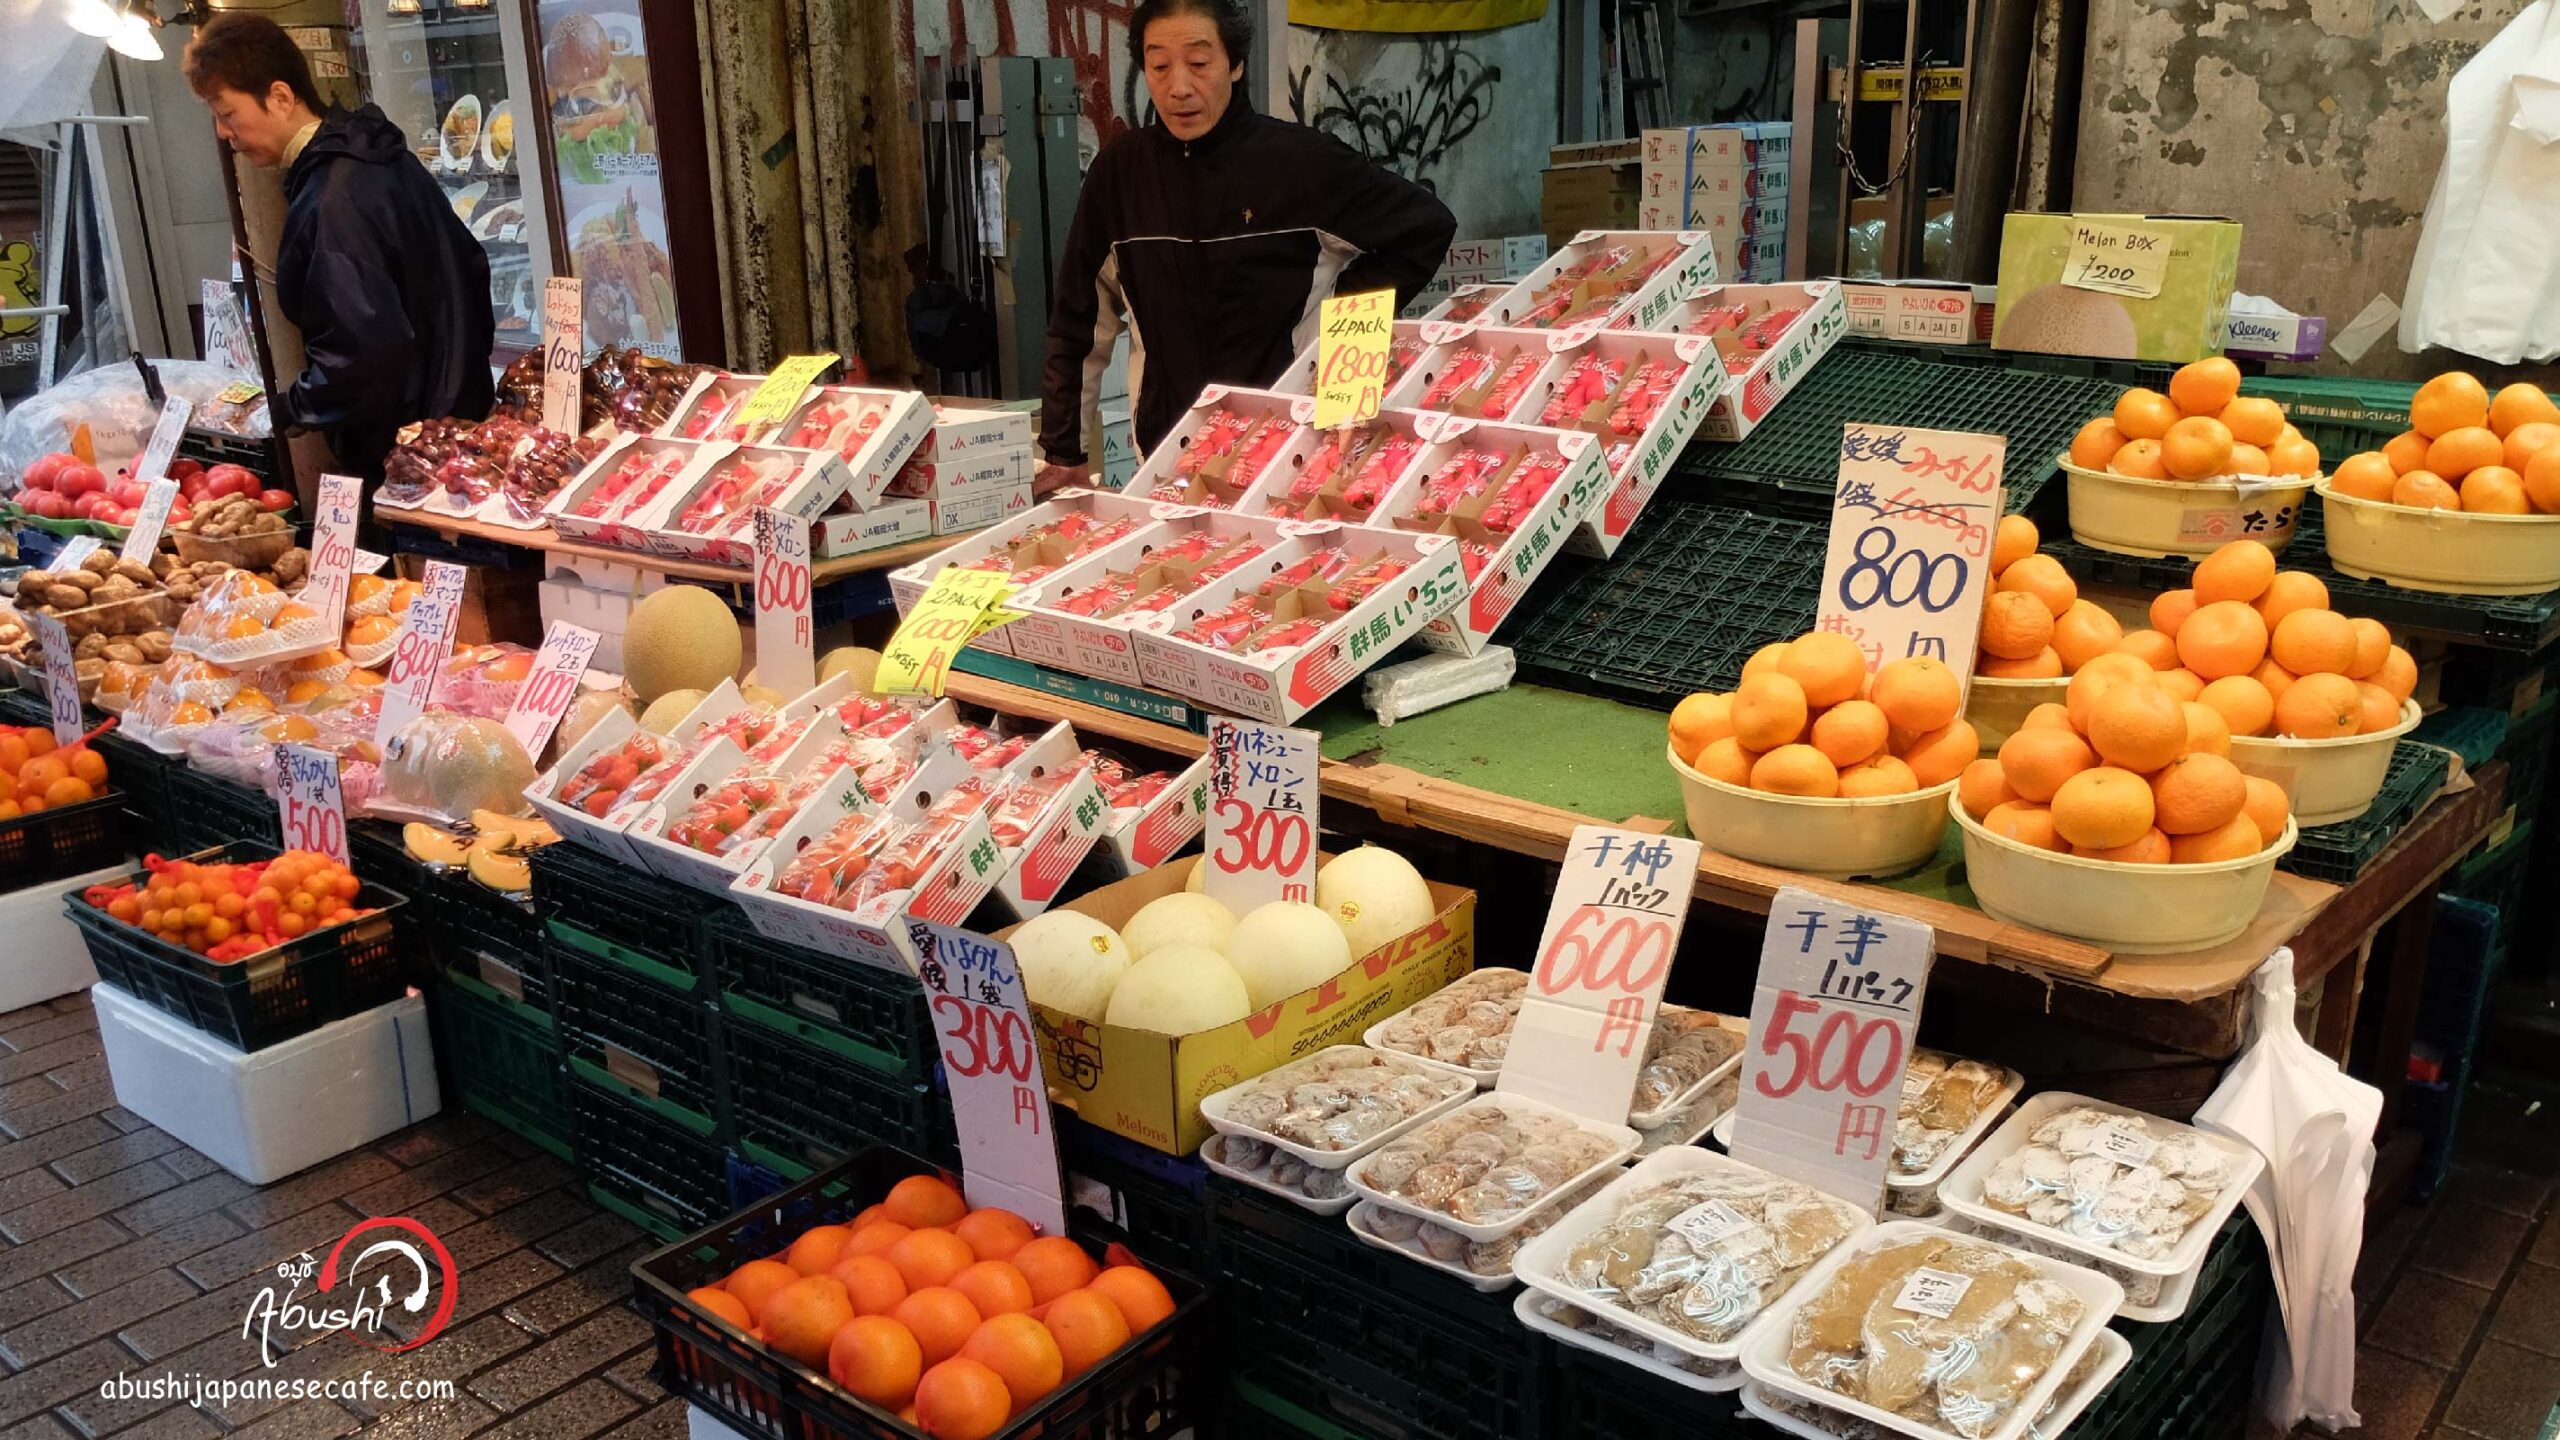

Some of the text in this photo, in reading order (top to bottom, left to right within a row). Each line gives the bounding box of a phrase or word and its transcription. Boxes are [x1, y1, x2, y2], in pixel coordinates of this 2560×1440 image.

[2078, 228, 2116, 248] Melon
[1450, 246, 1489, 266] トマト
[2080, 255, 2135, 282] ¥200
[1641, 250, 1712, 329] 群馬いちご
[1332, 295, 1384, 315] イチゴ
[1327, 317, 1387, 337] 4PACK
[1778, 300, 1842, 380] 群馬いちご
[1873, 318, 1880, 328] M
[1919, 322, 1926, 331] A
[1933, 323, 1943, 332] 2A
[1951, 324, 1957, 333] B
[2229, 320, 2280, 342] Kleenex
[17, 343, 35, 353] JS
[1324, 391, 1353, 404] SWEET
[1643, 357, 1718, 479] 群馬いちご
[1842, 427, 1995, 493] 愛媛 みかん
[945, 513, 959, 527] DX
[1515, 453, 1601, 577] 群馬いちご
[776, 535, 805, 557] メロン
[437, 566, 464, 584] アップル
[758, 553, 810, 613] 600
[942, 571, 999, 589] イチゴ
[1840, 526, 1968, 613] 800
[411, 601, 442, 619] アップル
[927, 588, 984, 609] 2PACK
[1350, 560, 1458, 661] 群馬いちご
[795, 616, 809, 648] 円
[391, 631, 438, 684] 800
[556, 653, 580, 670] 2玉
[888, 648, 920, 676] SWEET
[1122, 661, 1129, 672] B
[408, 679, 426, 707] 円
[1188, 677, 1197, 690] M
[1219, 687, 1226, 698] S
[1234, 692, 1241, 702] A
[1263, 701, 1271, 712] B
[528, 722, 552, 752] 円
[291, 755, 336, 788] きんかん
[1248, 761, 1304, 787] メロン
[1267, 789, 1303, 811] 1玉
[288, 797, 341, 857] 500
[1214, 798, 1310, 877] 300
[1585, 835, 1673, 885] 干柿
[1600, 877, 1669, 906] 1パック
[1537, 903, 1674, 996] 600
[1785, 910, 1887, 965] 干芋
[938, 935, 1014, 985] いよかん
[1819, 959, 1913, 1002] 1パック
[933, 995, 1032, 1082] 300
[1594, 997, 1644, 1058] 円
[1755, 990, 1902, 1098] 500
[1013, 1085, 1039, 1135] 円
[1116, 1112, 1168, 1145] Melons
[1834, 1102, 1885, 1160] 円
